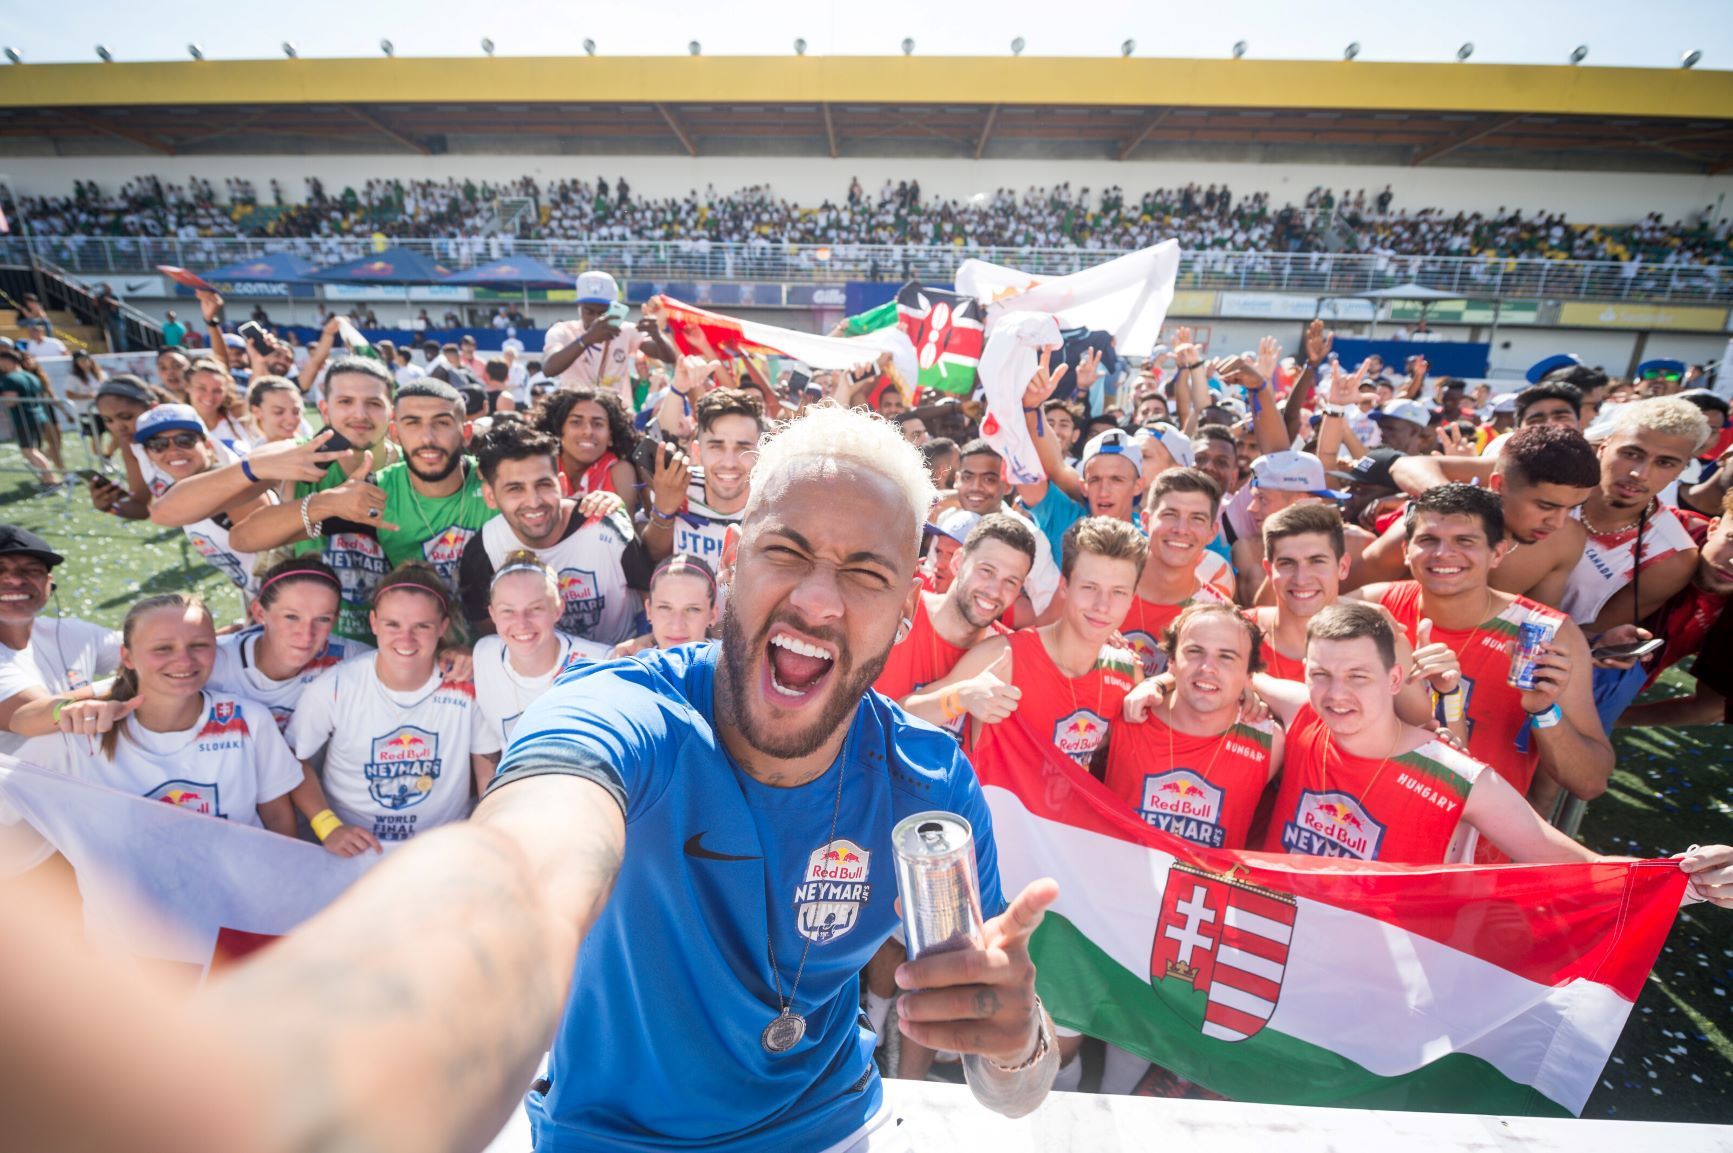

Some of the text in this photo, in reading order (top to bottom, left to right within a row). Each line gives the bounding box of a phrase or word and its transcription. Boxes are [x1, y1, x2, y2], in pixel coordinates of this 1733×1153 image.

[322, 553, 384, 573] NEYMAR
[1585, 549, 1614, 580] CANADA
[1060, 737, 1080, 750] Red
[380, 749, 430, 761] Red Bull
[367, 762, 432, 776] NEYMAR
[1397, 773, 1457, 813] HUNGARY
[1150, 795, 1211, 818] Red Bull
[375, 815, 417, 824] WORLD
[372, 824, 415, 833] FINAL
[1304, 812, 1367, 854] Red Bull
[812, 865, 863, 880] Red Bull
[794, 882, 862, 903] NEYMAR
